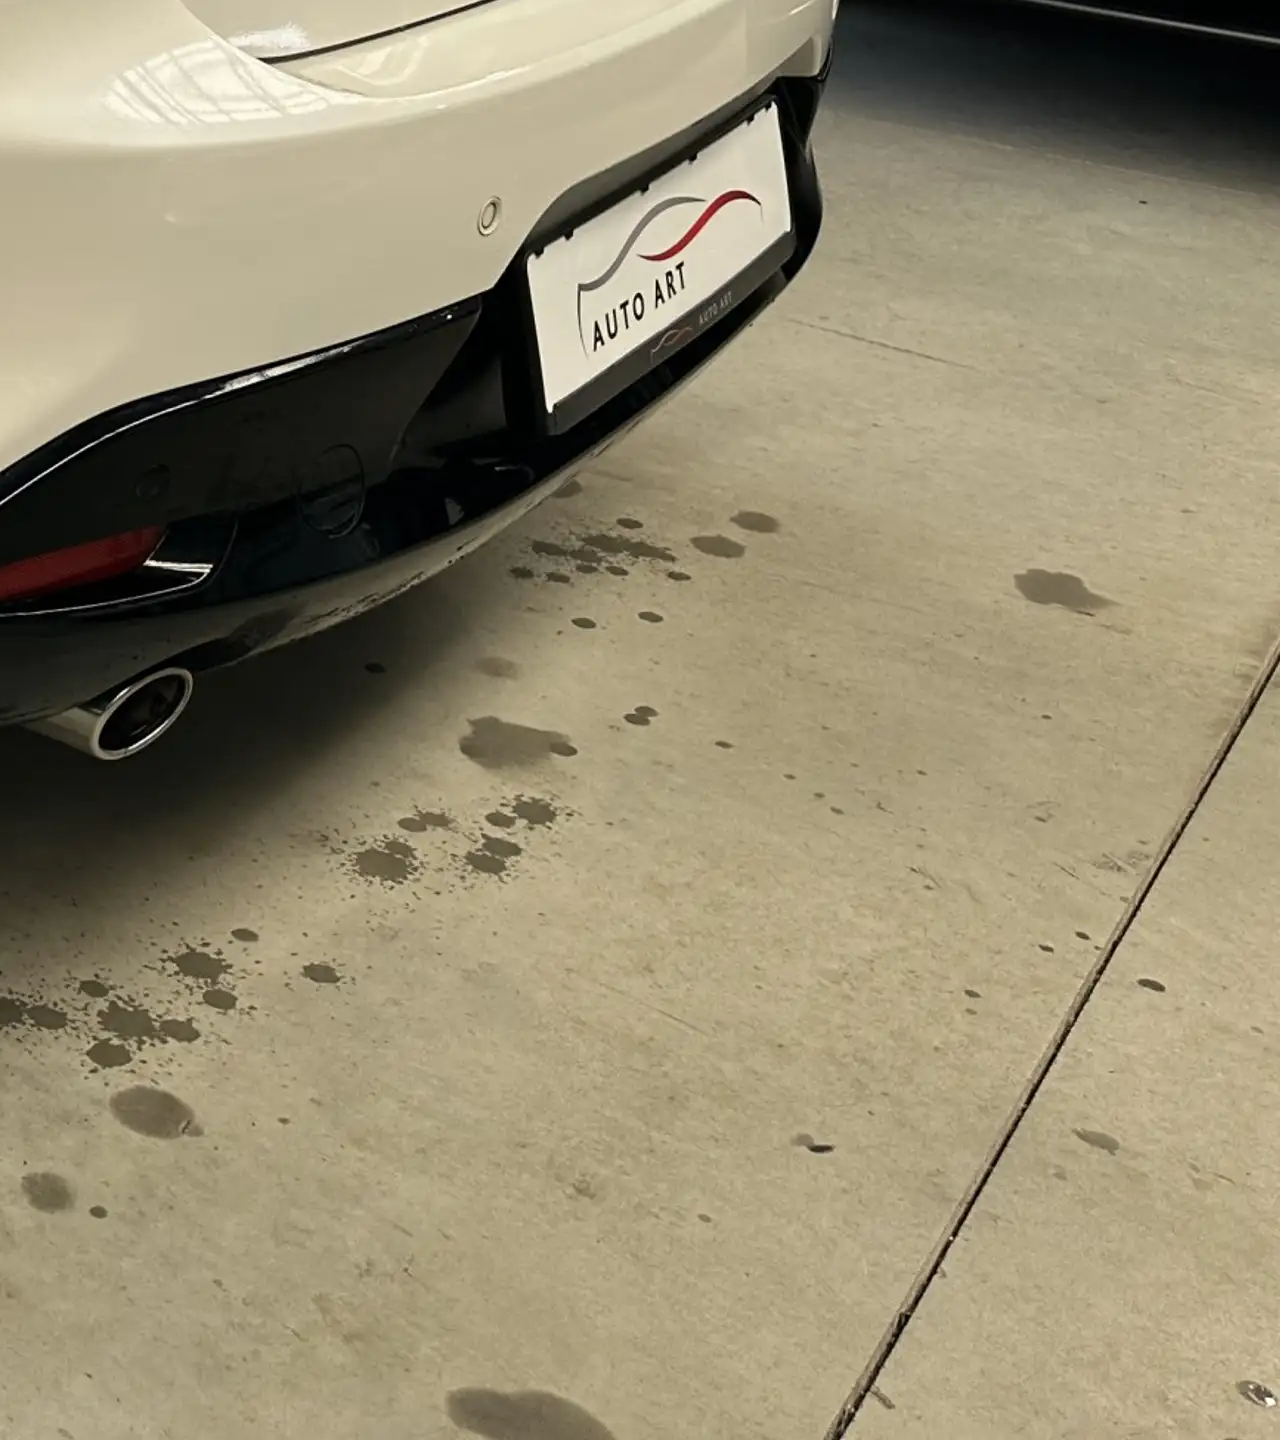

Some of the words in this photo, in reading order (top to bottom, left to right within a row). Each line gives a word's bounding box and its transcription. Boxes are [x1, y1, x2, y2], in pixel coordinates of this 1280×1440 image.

[593, 292, 645, 352] AUTO
[654, 261, 687, 309] ART
[698, 302, 718, 325] AUTO
[720, 290, 732, 309] ART
